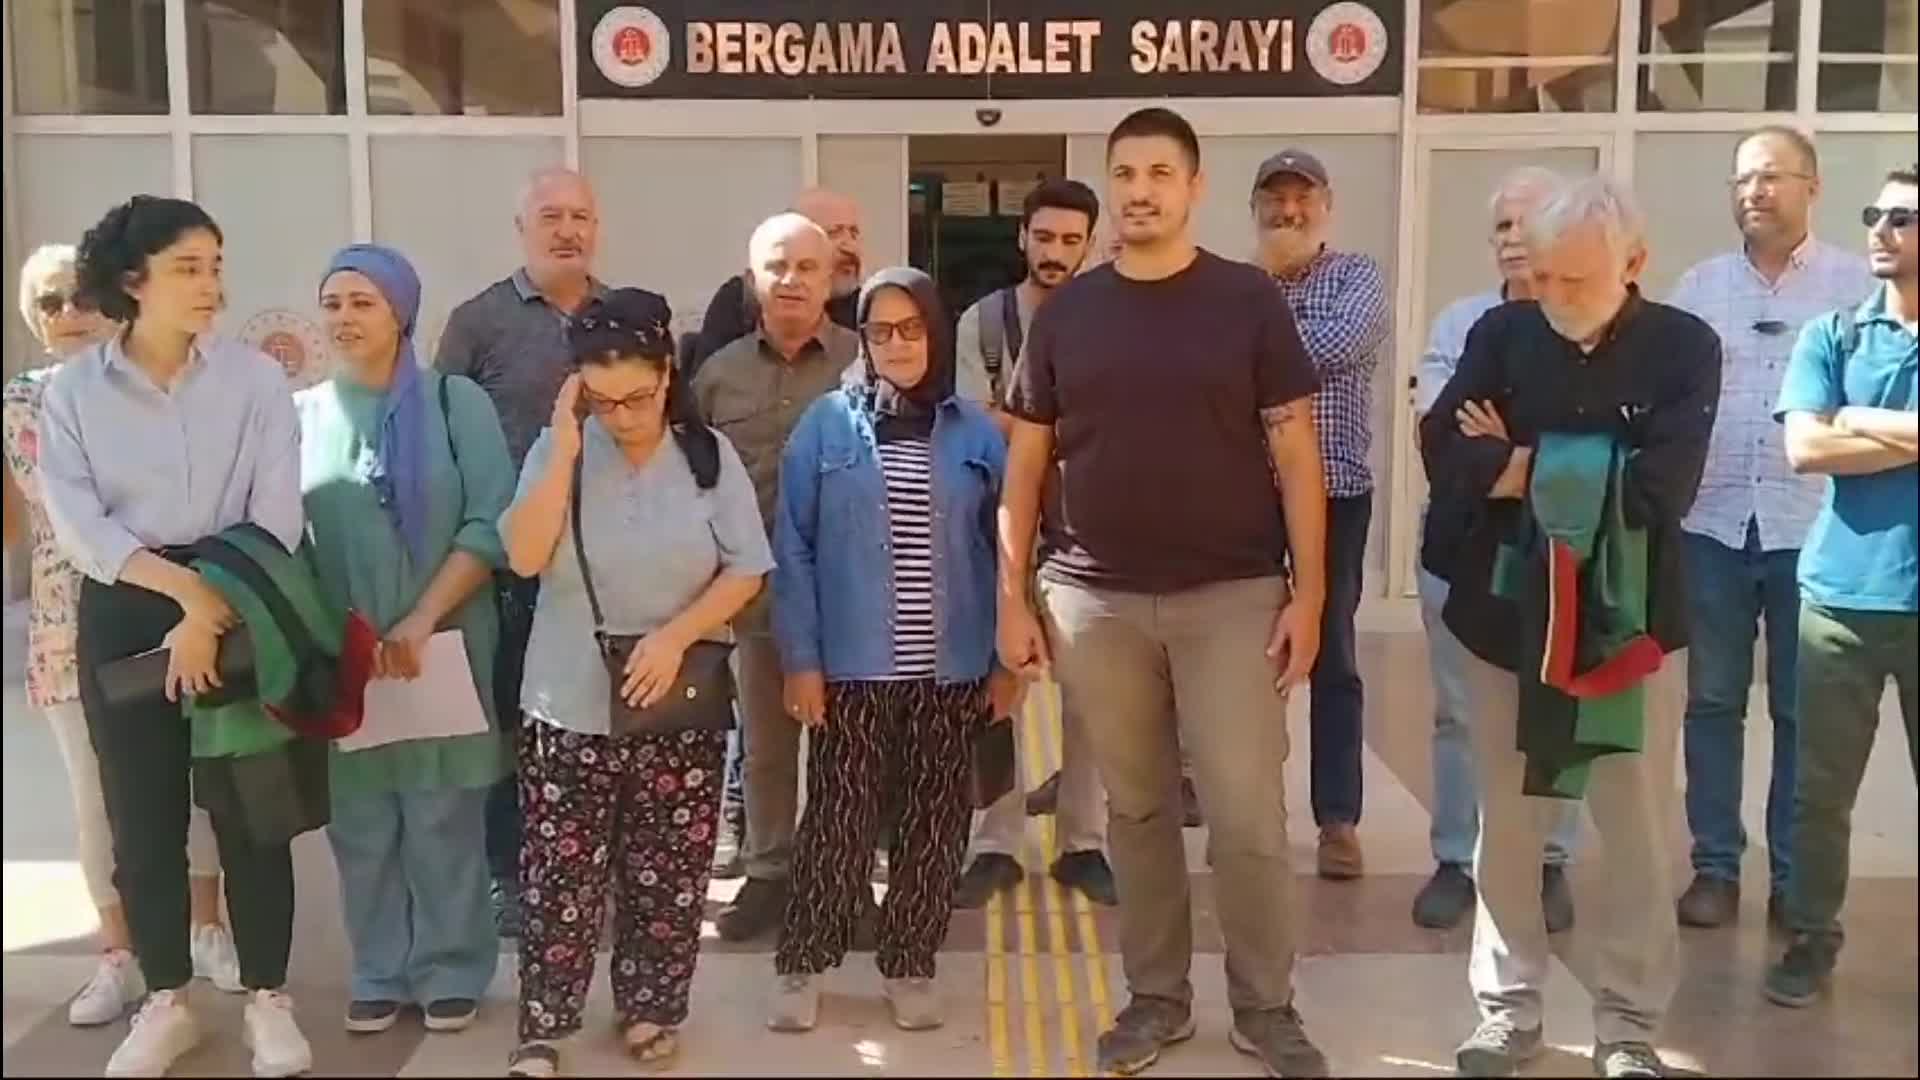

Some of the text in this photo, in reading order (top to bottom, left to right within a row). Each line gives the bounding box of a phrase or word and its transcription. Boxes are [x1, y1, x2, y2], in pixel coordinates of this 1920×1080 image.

[686, 19, 1294, 75] BERGAMA ADALET SARAYI
